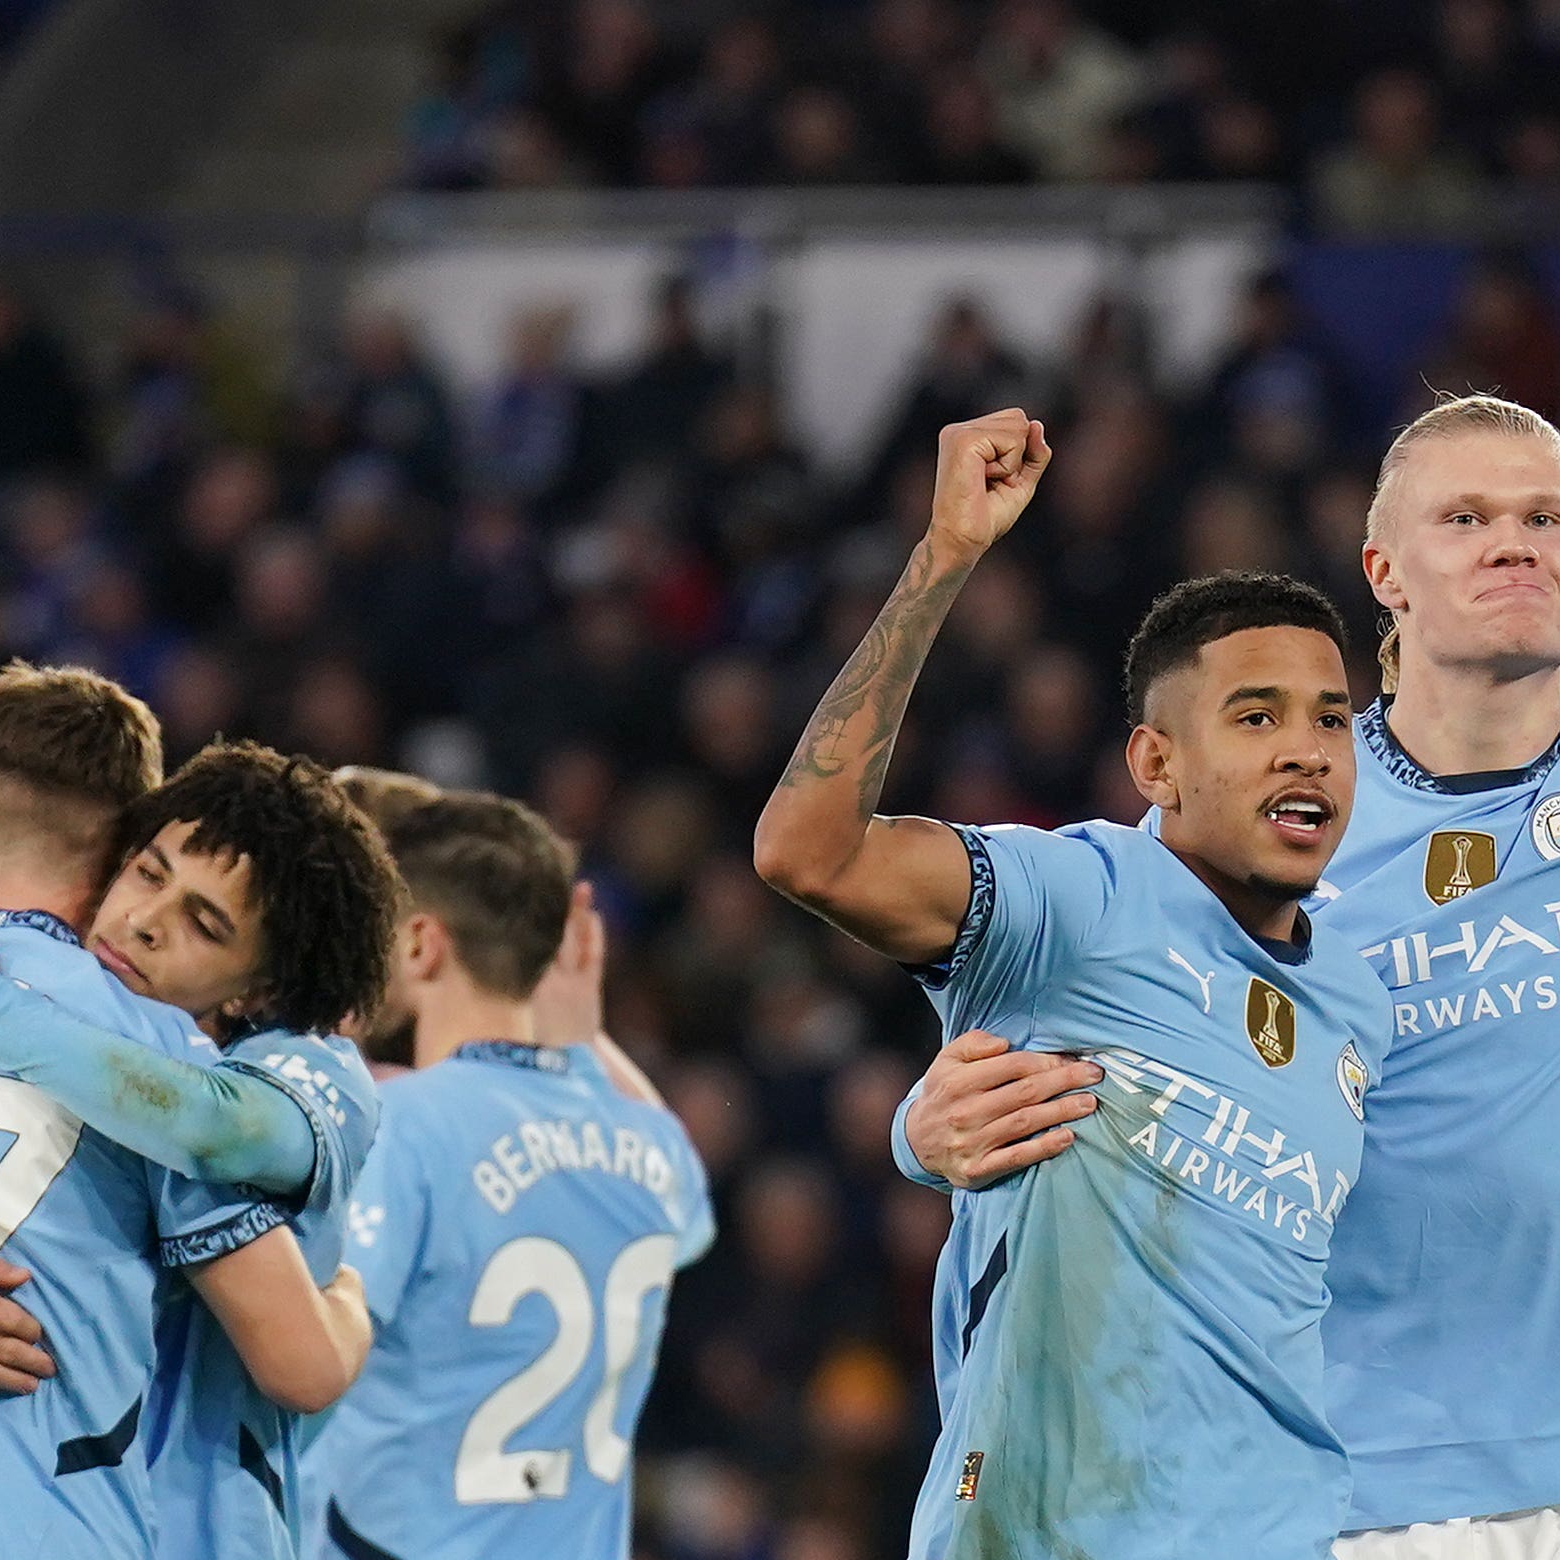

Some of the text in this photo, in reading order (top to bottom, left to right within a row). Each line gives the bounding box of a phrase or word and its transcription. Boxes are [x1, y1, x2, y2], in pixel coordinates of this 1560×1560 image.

[1394, 975, 1558, 1037] RWAYS
[1128, 1121, 1312, 1241] AIRWAYS
[453, 1234, 678, 1505] 20
